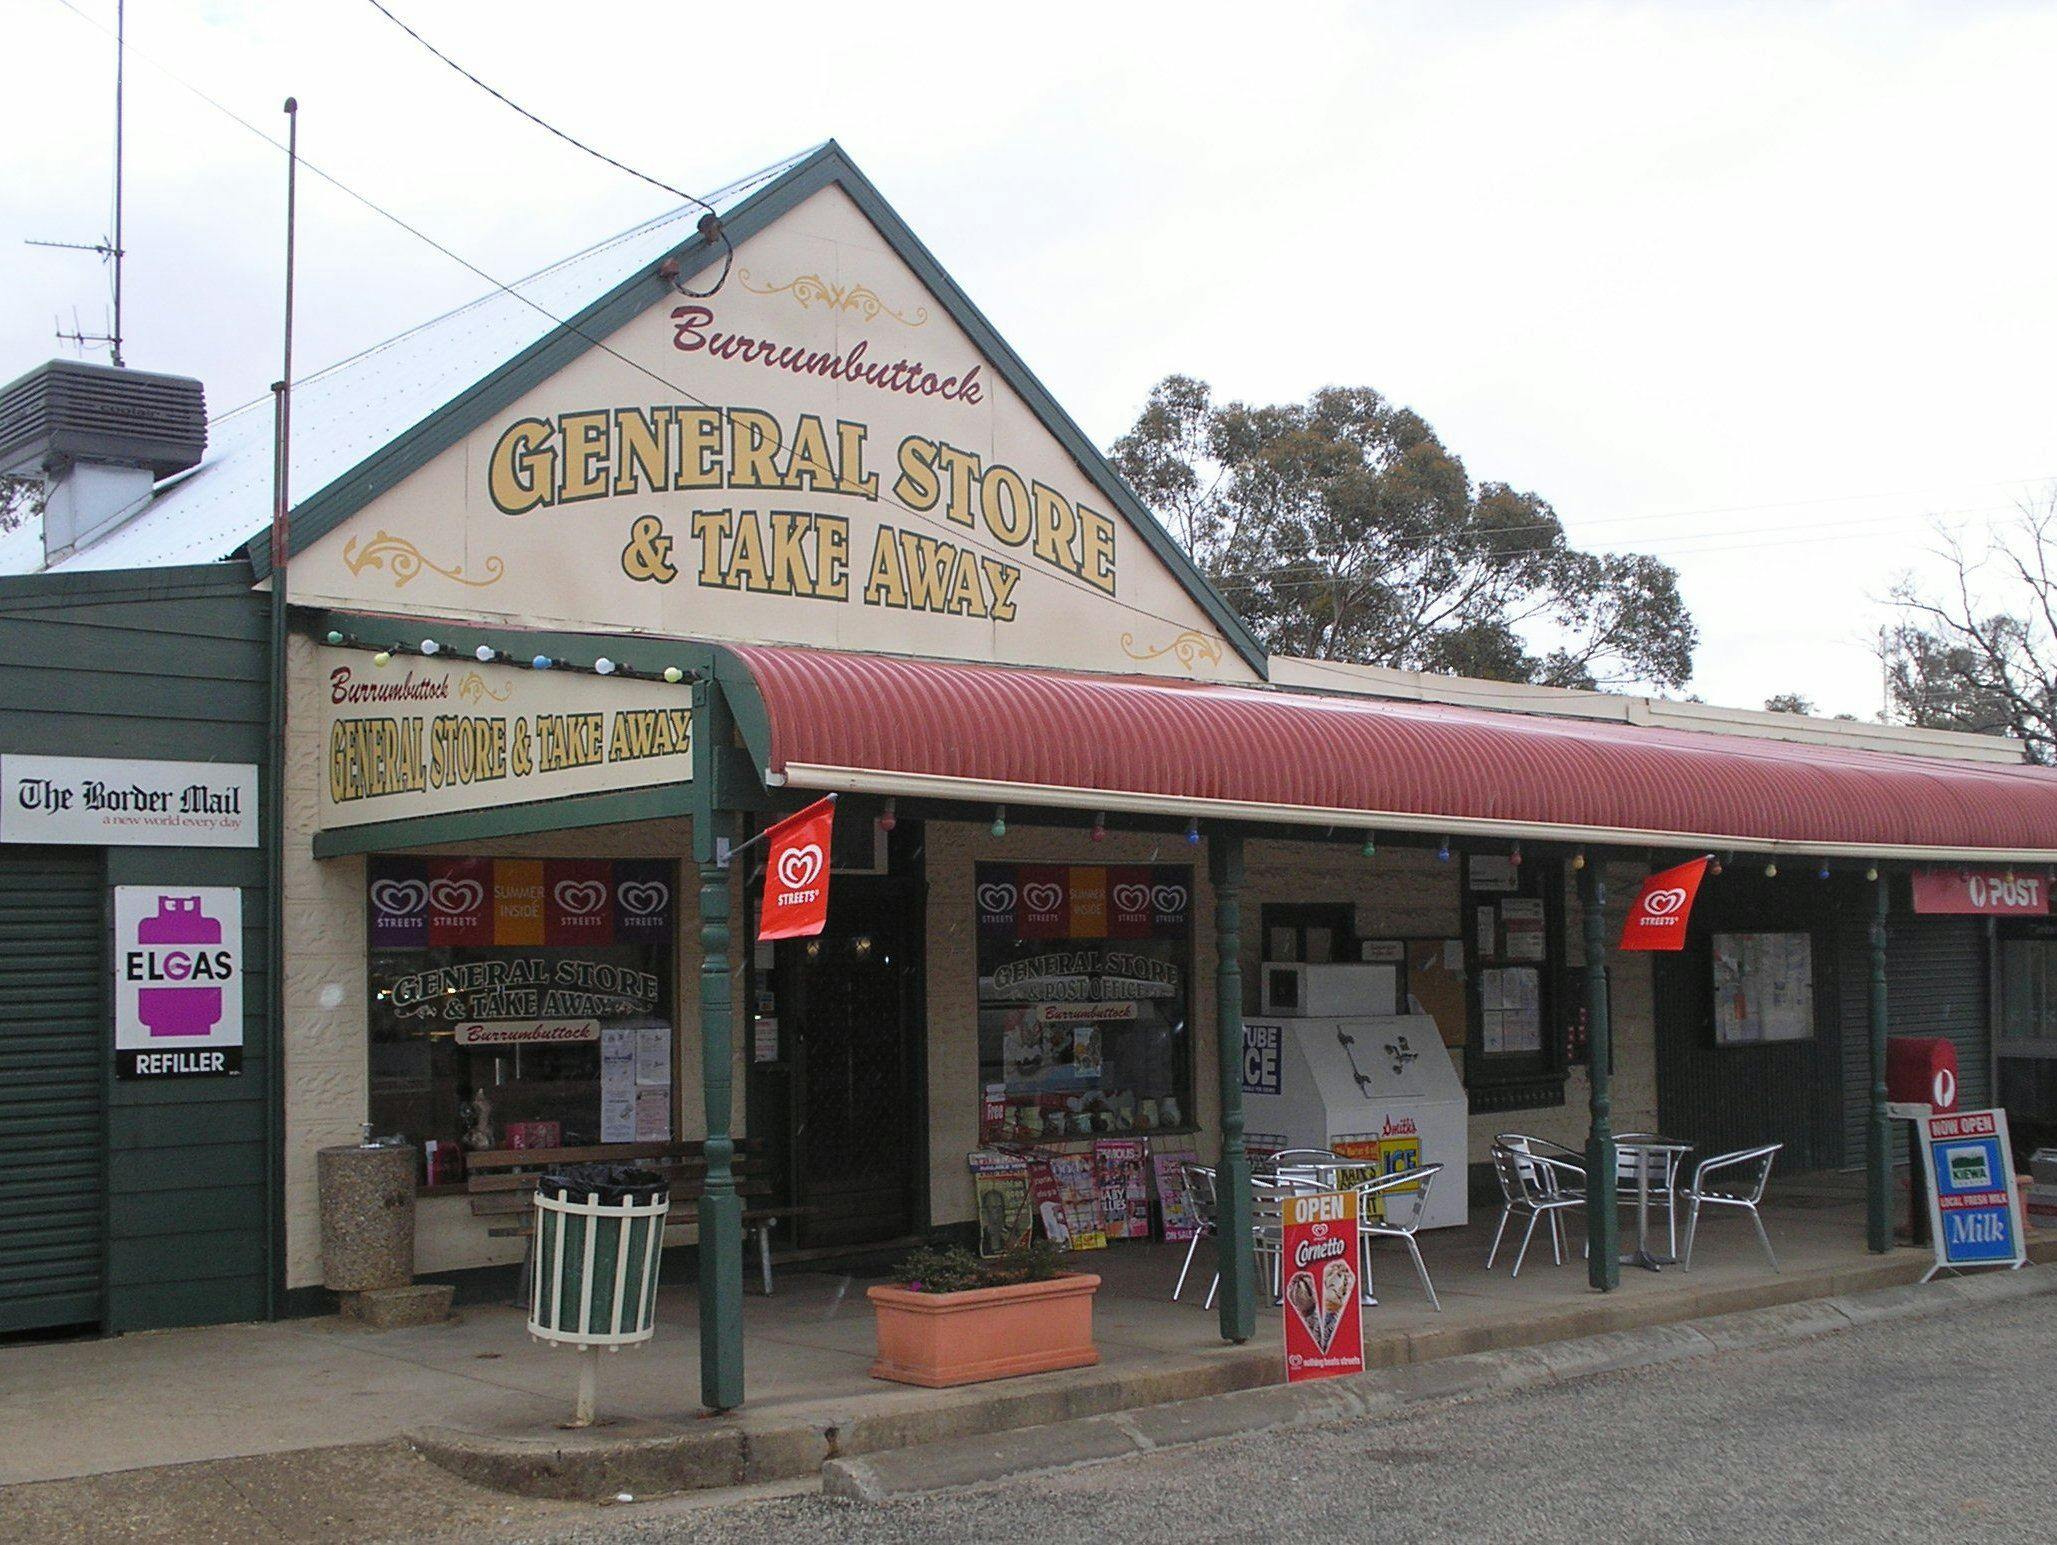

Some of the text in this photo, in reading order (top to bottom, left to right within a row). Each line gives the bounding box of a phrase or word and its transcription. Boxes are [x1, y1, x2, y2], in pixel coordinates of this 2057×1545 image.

[671, 305, 983, 405] Burrumbuttock
[488, 405, 1116, 596] GENERAL STORE
[622, 508, 1021, 622] & TAKE AWAY
[330, 666, 449, 704] Burrumbuttock
[329, 708, 692, 803] GENERAL STORE & TAKE AWAY
[19, 778, 241, 815] The Border Mail
[103, 814, 242, 831] a new world every day
[778, 890, 815, 906] STREETS
[1988, 878, 2039, 906] POST
[377, 917, 423, 928] STREETS
[433, 917, 477, 926] STREETS
[561, 917, 601, 926] STREETS
[624, 917, 663, 926] STREETS
[1640, 917, 1675, 926] STREETS
[127, 951, 232, 981] ELGAS
[993, 951, 1178, 990] GENERAL STORE
[392, 959, 659, 1007] GENERAL STORE
[444, 999, 467, 1020] &
[473, 990, 539, 1019] TAKE
[466, 1023, 590, 1042] Burrumbuttock
[1244, 1026, 1277, 1048] UBE
[136, 1052, 225, 1075] REFILLER
[1244, 1049, 1277, 1085] CE
[1931, 1116, 1993, 1136] NOW OPEN
[1295, 1194, 1344, 1222] OPEN
[1952, 1213, 2004, 1243] Milk
[1295, 1239, 1345, 1267] Cornetto
